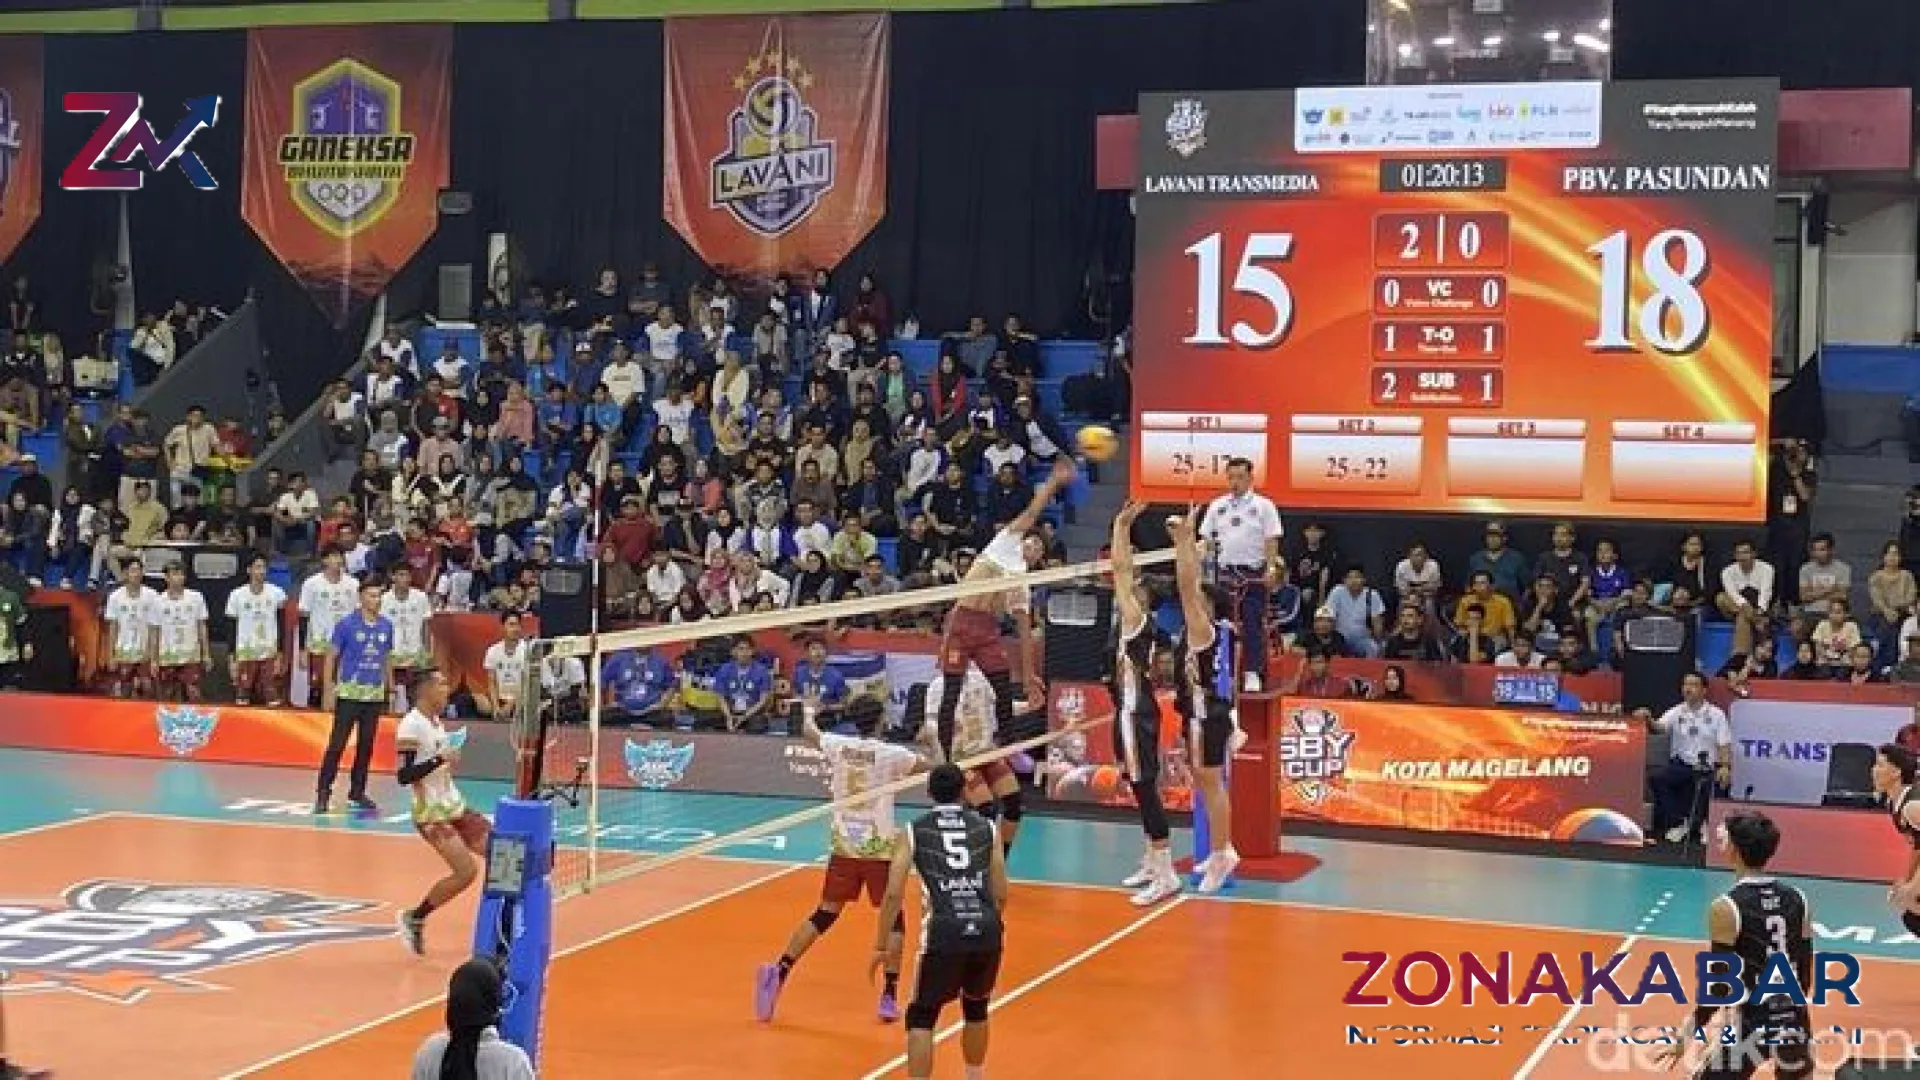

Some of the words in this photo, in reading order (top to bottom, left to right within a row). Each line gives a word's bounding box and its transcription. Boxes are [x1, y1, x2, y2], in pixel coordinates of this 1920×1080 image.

[720, 146, 824, 193] LAVANI
[1402, 163, 1485, 188] 01:20:13
[1562, 166, 1619, 190] PBV.
[1624, 164, 1771, 190] PASUNDAN
[1145, 175, 1205, 193] LAVANI
[1207, 174, 1320, 193] TRANSMEDIA
[1400, 222, 1420, 259] 2
[1458, 221, 1482, 259] 0
[1183, 231, 1295, 350] 15
[1383, 279, 1400, 308] 0
[1427, 279, 1452, 297] VC
[1483, 279, 1499, 308] 0
[1583, 228, 1711, 355] 18
[1384, 325, 1397, 352] 1
[1421, 326, 1456, 343] T-O
[1483, 325, 1494, 352] 1
[1382, 372, 1398, 400] 2
[1418, 372, 1456, 388] SUB
[1481, 373, 1493, 401] 1
[1187, 416, 1213, 428] SET
[1338, 419, 1364, 432] SET
[1497, 422, 1526, 435] SET
[1662, 425, 1690, 438] SET
[1173, 454, 1194, 475] 25
[1325, 456, 1349, 479] 25
[1365, 456, 1389, 479] 22
[1281, 733, 1351, 760] SBY
[1739, 739, 1829, 762] TRANS
[1287, 759, 1343, 777] CUP
[1381, 758, 1441, 781] KOTA
[1447, 755, 1592, 779] MAGELANG
[941, 831, 972, 863] 5
[1765, 914, 1788, 956] 3
